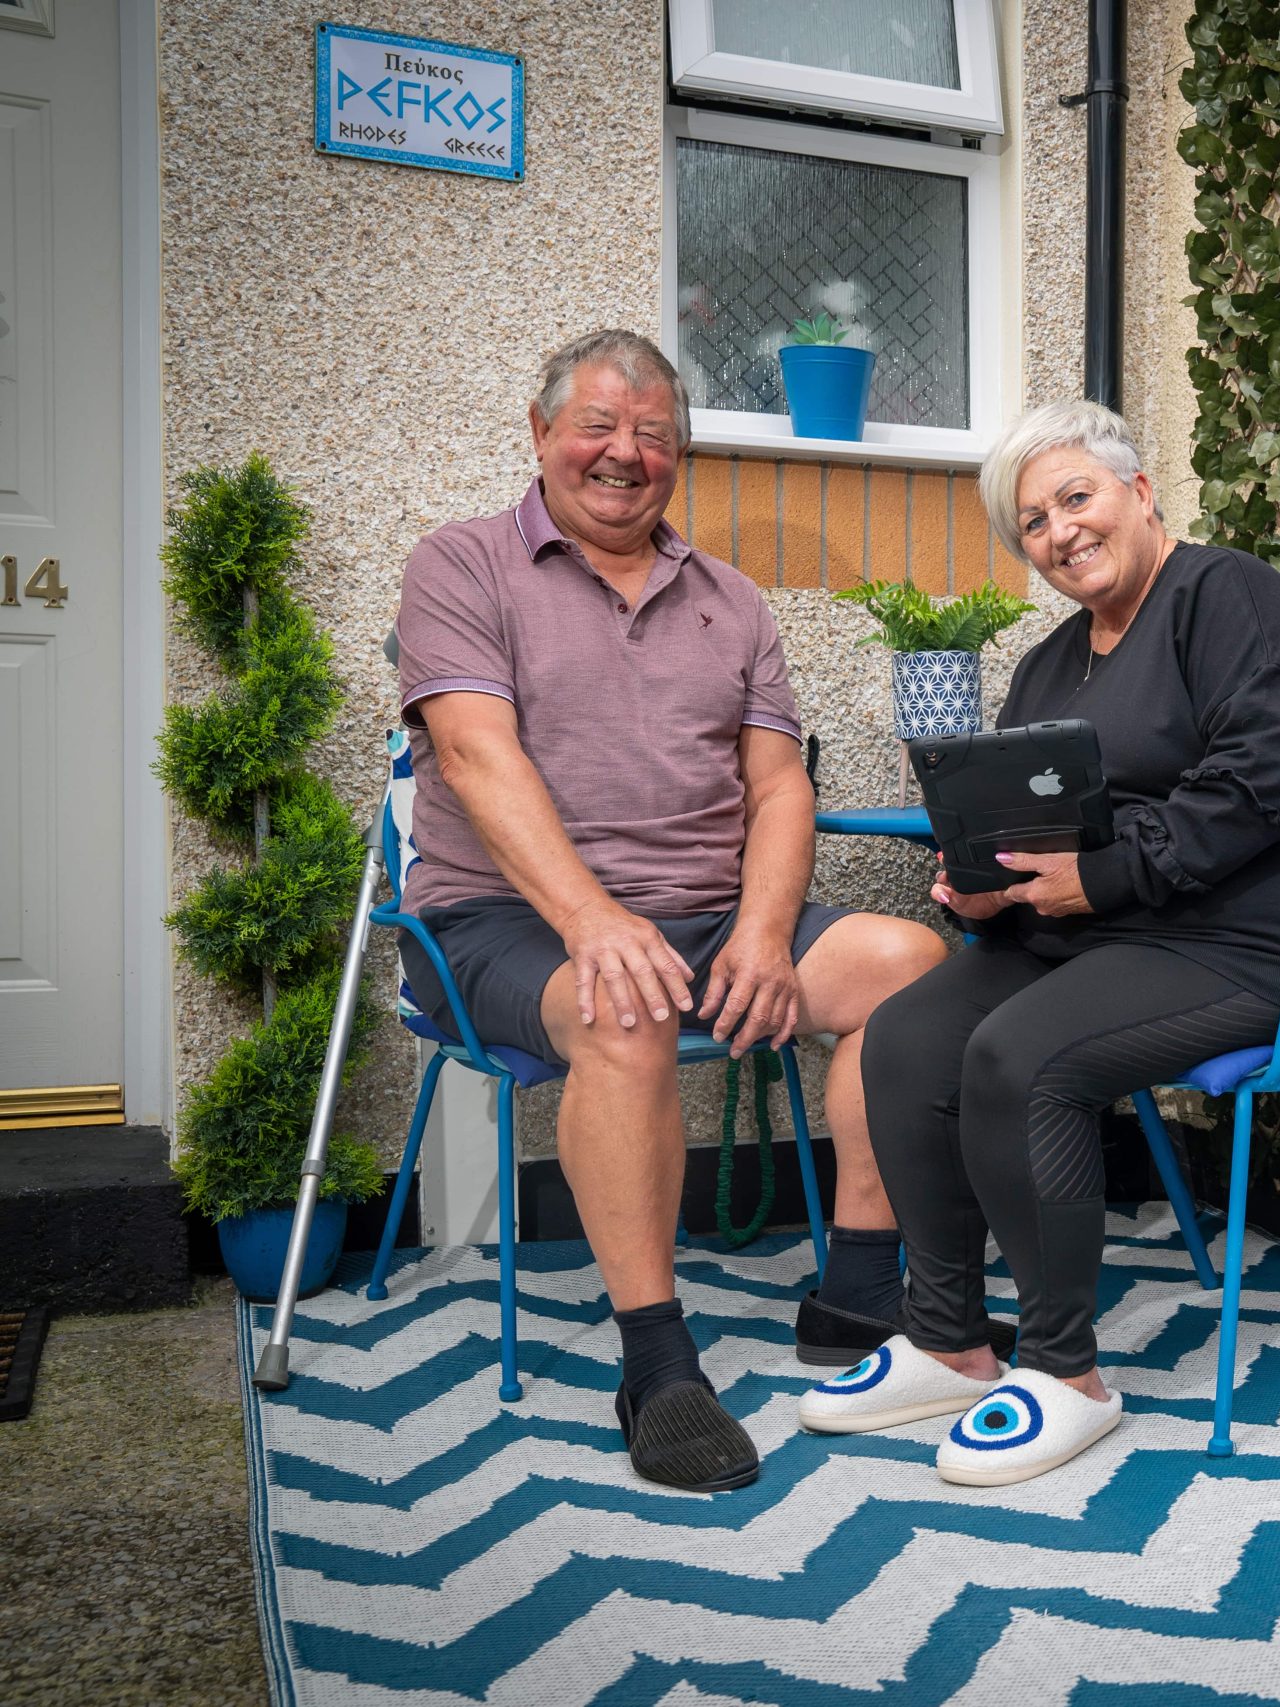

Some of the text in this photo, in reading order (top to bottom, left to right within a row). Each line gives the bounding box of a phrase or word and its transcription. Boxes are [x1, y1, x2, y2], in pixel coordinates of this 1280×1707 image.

[385, 53, 463, 85] Πεύκος
[337, 68, 506, 134] PEFKOS
[339, 121, 505, 160] RHODES GREECE
[0, 555, 68, 608] 14
